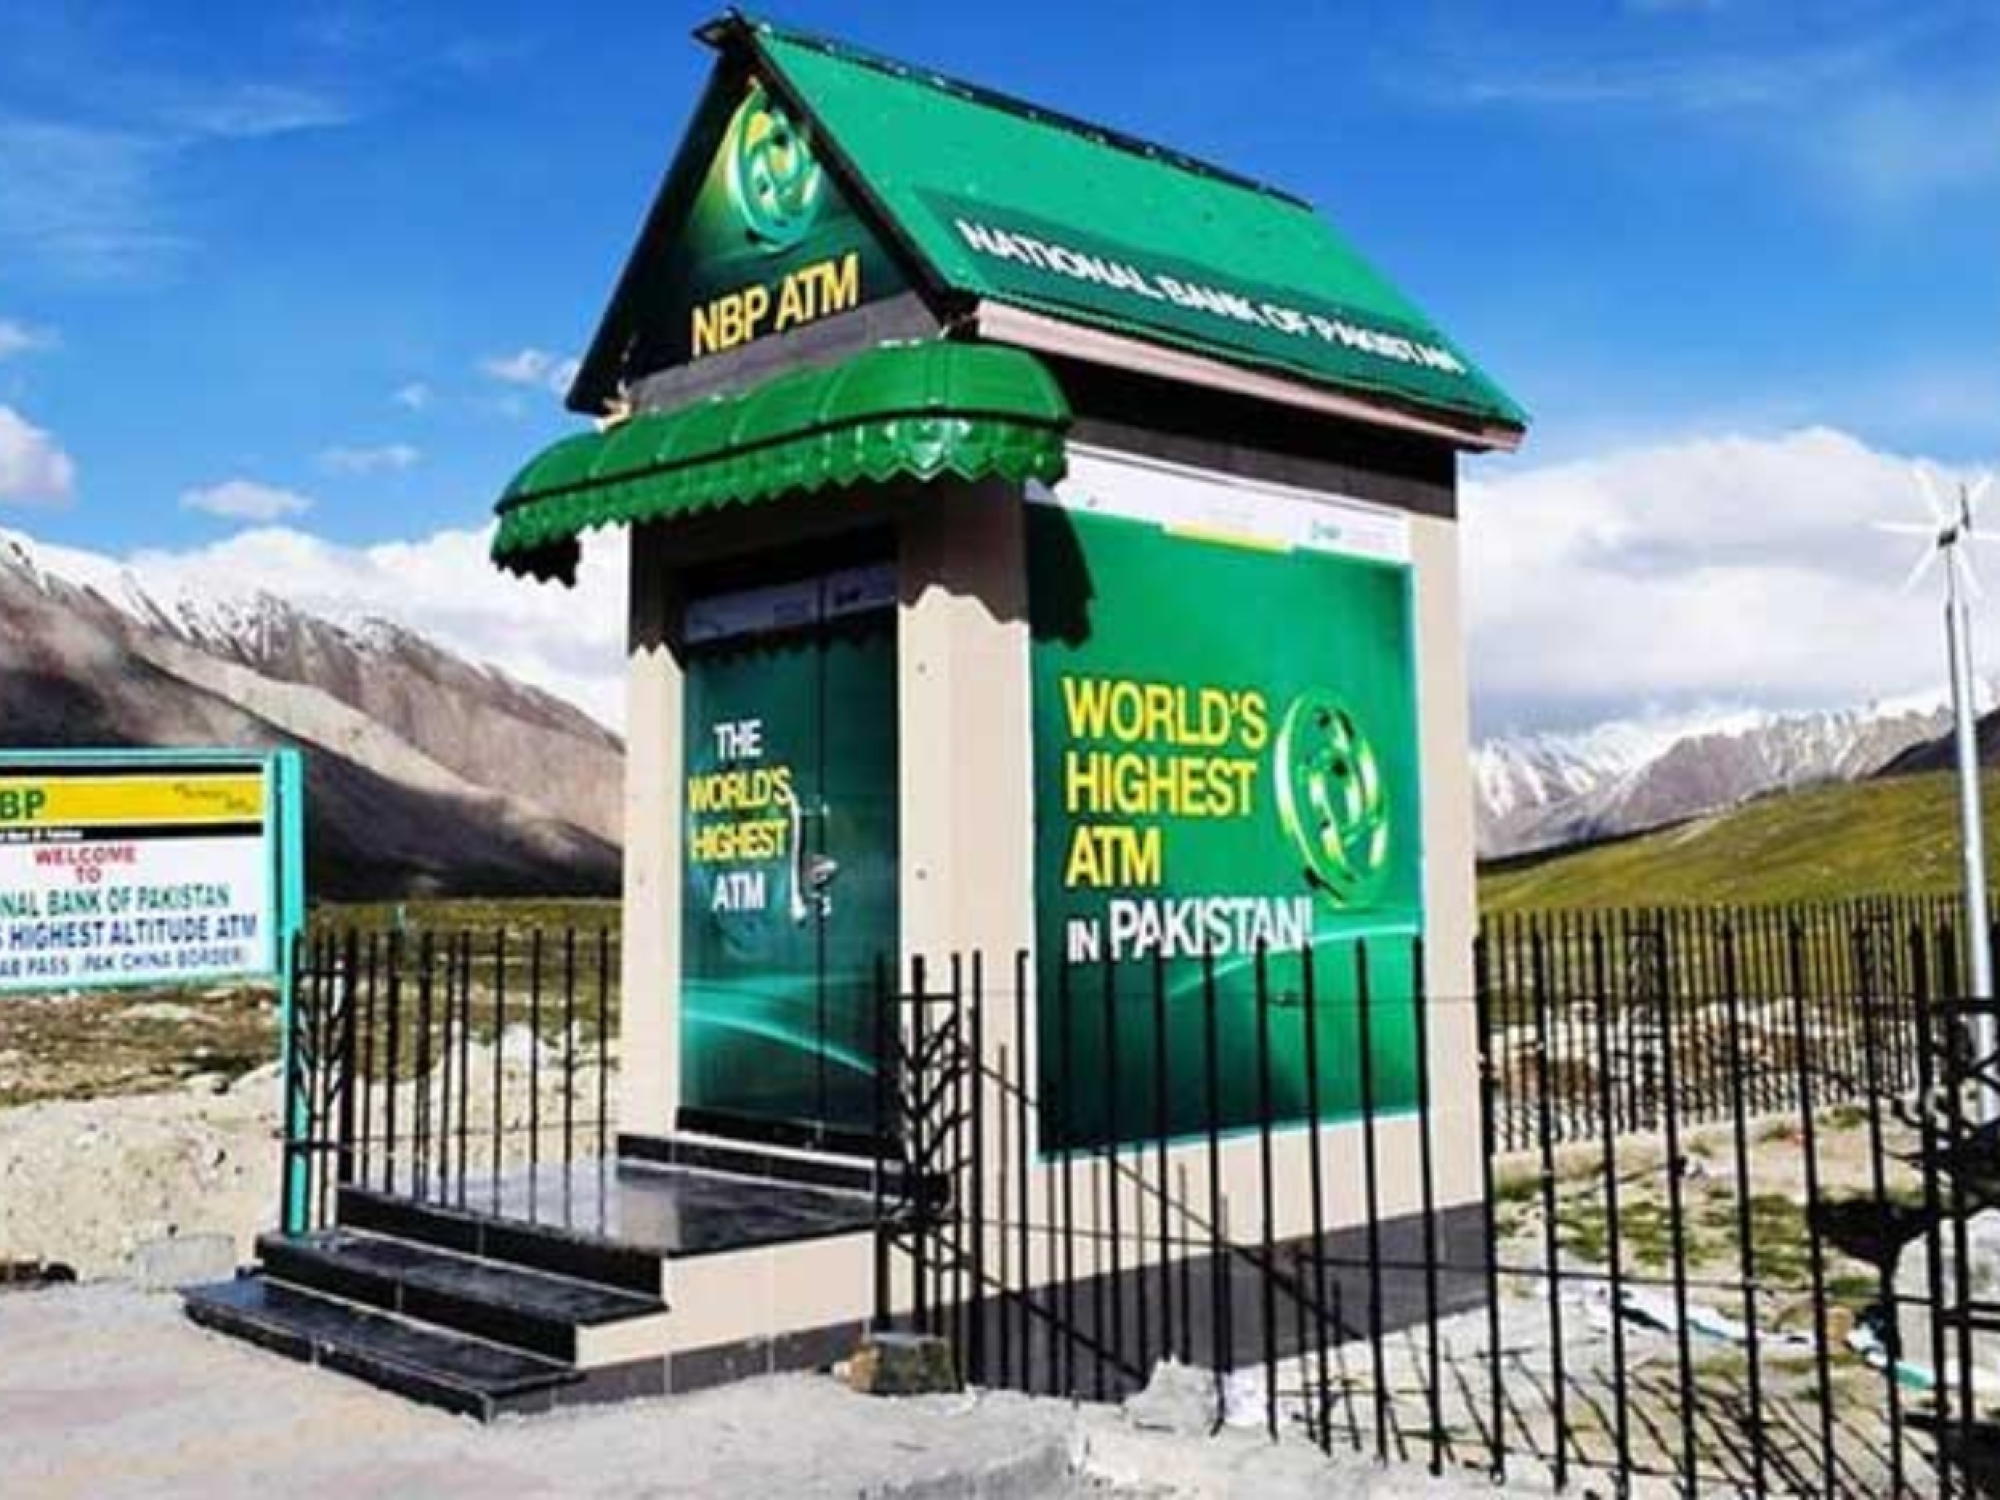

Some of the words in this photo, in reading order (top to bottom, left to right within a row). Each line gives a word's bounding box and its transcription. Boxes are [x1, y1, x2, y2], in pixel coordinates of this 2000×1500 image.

[954, 217, 1165, 300] NATIONAL
[691, 283, 769, 358] NBP
[774, 251, 860, 332] ATM
[1062, 676, 1267, 750] WORLD'S
[713, 719, 763, 761] THE
[688, 765, 792, 814] WORLD'S
[1066, 751, 1258, 816] HIGHEST
[35, 846, 136, 866] WELCOME
[690, 817, 789, 864] HIGHEST
[1065, 825, 1162, 887] ATM
[75, 865, 101, 884] TO
[711, 870, 766, 912] ATM
[47, 886, 101, 916] BANK
[107, 885, 132, 914] OF
[137, 882, 230, 912] PAKISTAN
[9, 920, 104, 950] HIGHEST
[110, 914, 209, 945] ALTITUDE
[216, 912, 257, 939] ATM
[1067, 918, 1099, 962] IN
[1109, 896, 1313, 960] PAKISTAN!
[26, 954, 69, 976] PASS
